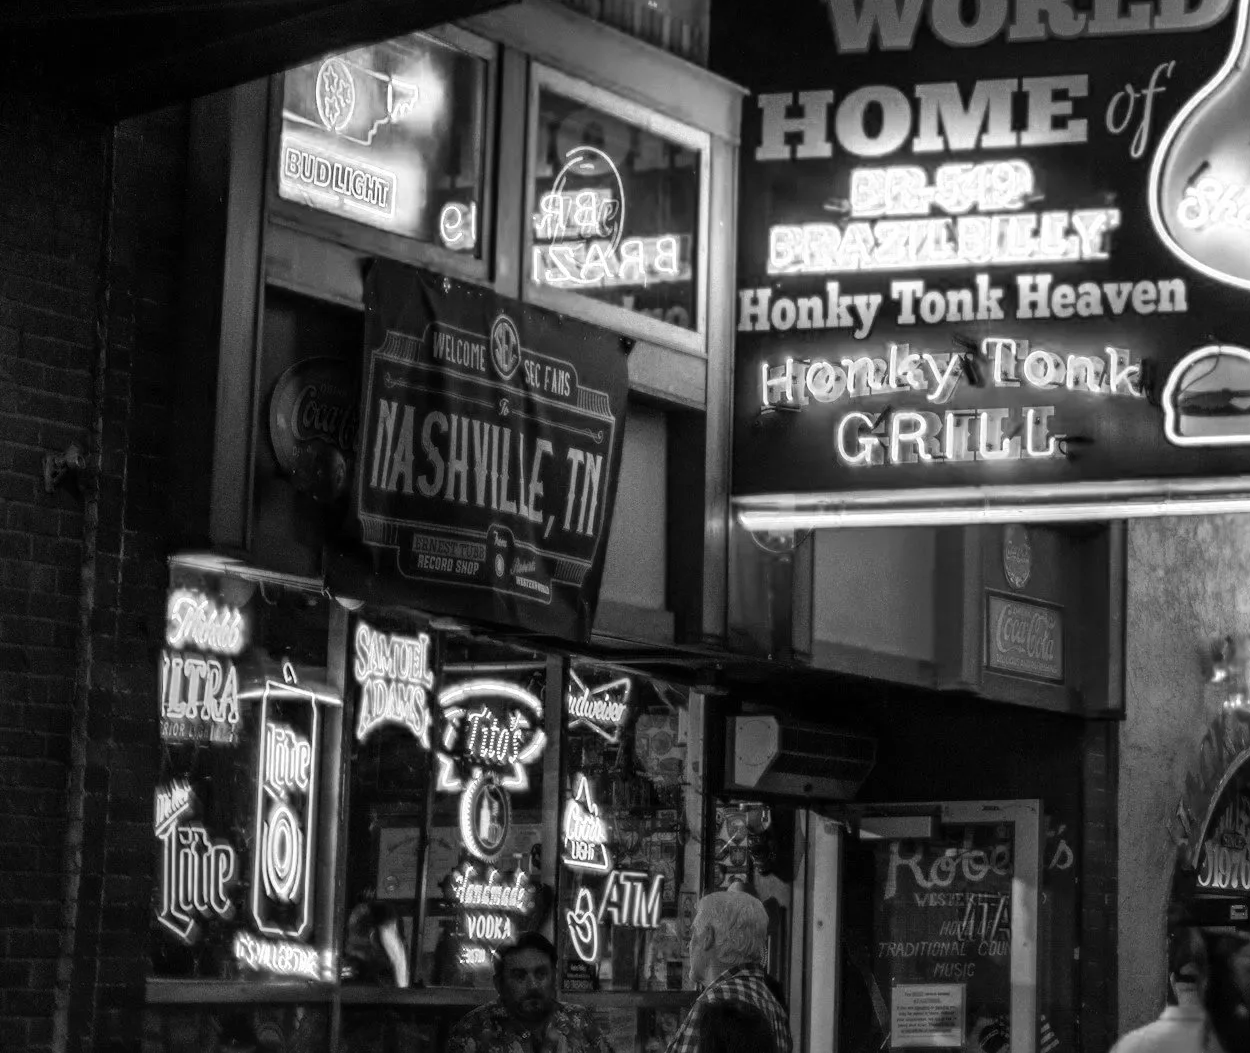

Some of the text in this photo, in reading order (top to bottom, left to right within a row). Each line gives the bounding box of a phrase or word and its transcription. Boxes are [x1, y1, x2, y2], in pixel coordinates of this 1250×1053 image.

[755, 61, 1175, 161] HOME of
[285, 147, 390, 208] BUD LIGHT
[738, 274, 1187, 339] Honky Tonk Heaven
[432, 331, 487, 373] WELCOME
[524, 359, 571, 397] SEC FANS
[761, 336, 1146, 413] Honky Tonk
[837, 405, 1068, 466] GRILL
[370, 398, 603, 538] NASHVILLE, TN
[417, 554, 480, 575] RECORD SHOP
[355, 622, 434, 689] SAMUEL
[357, 678, 431, 748] ADAMS
[568, 687, 626, 722] udweiser
[467, 914, 513, 940] VODKA
[598, 870, 664, 928] ATM
[878, 941, 1011, 958] TRADITIONAL COUN
[933, 961, 976, 978] MUSIC
